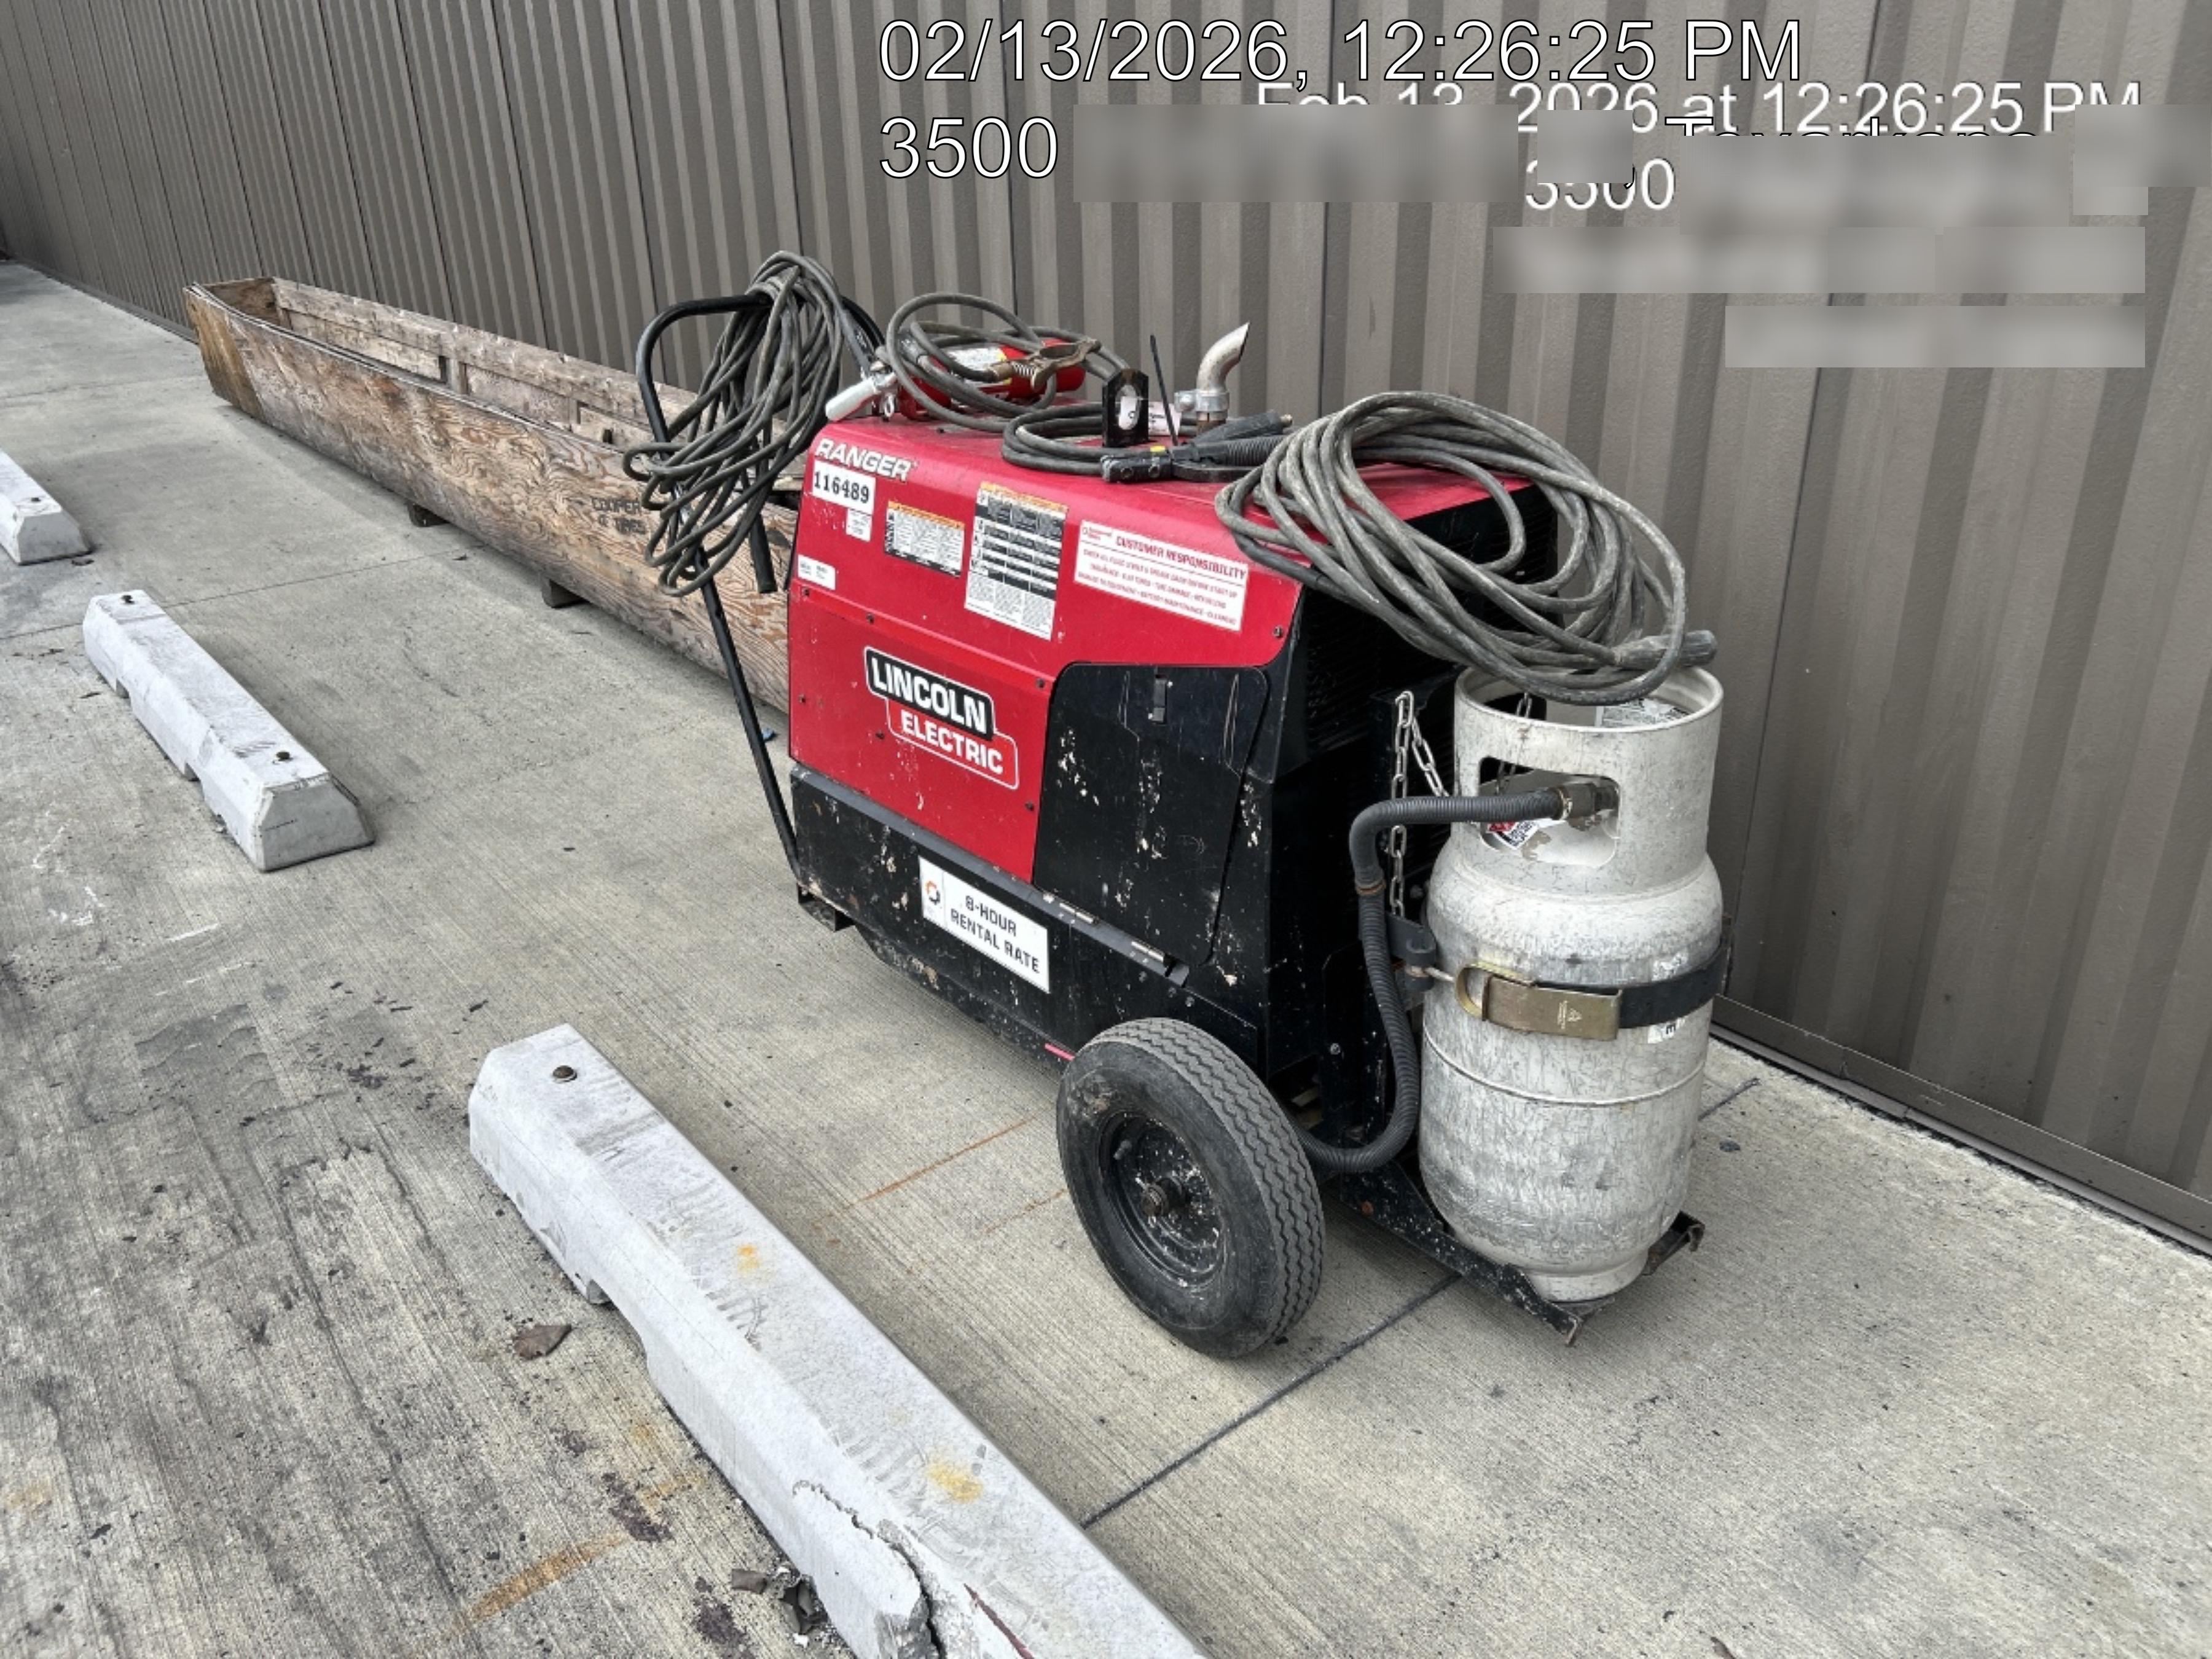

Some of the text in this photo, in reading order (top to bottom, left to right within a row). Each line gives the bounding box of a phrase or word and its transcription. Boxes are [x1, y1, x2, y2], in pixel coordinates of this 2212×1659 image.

[815, 437, 912, 482] RANGER
[814, 471, 869, 503] 116489
[1116, 536, 1164, 557] CUSTOMER
[1166, 550, 1246, 579] RESPONSIBILITY
[871, 657, 987, 734] LINCOLN
[900, 708, 1004, 775] ELECTRIC
[966, 895, 1017, 937] 8-HOUR
[951, 908, 1040, 973] RENTAL RATE
